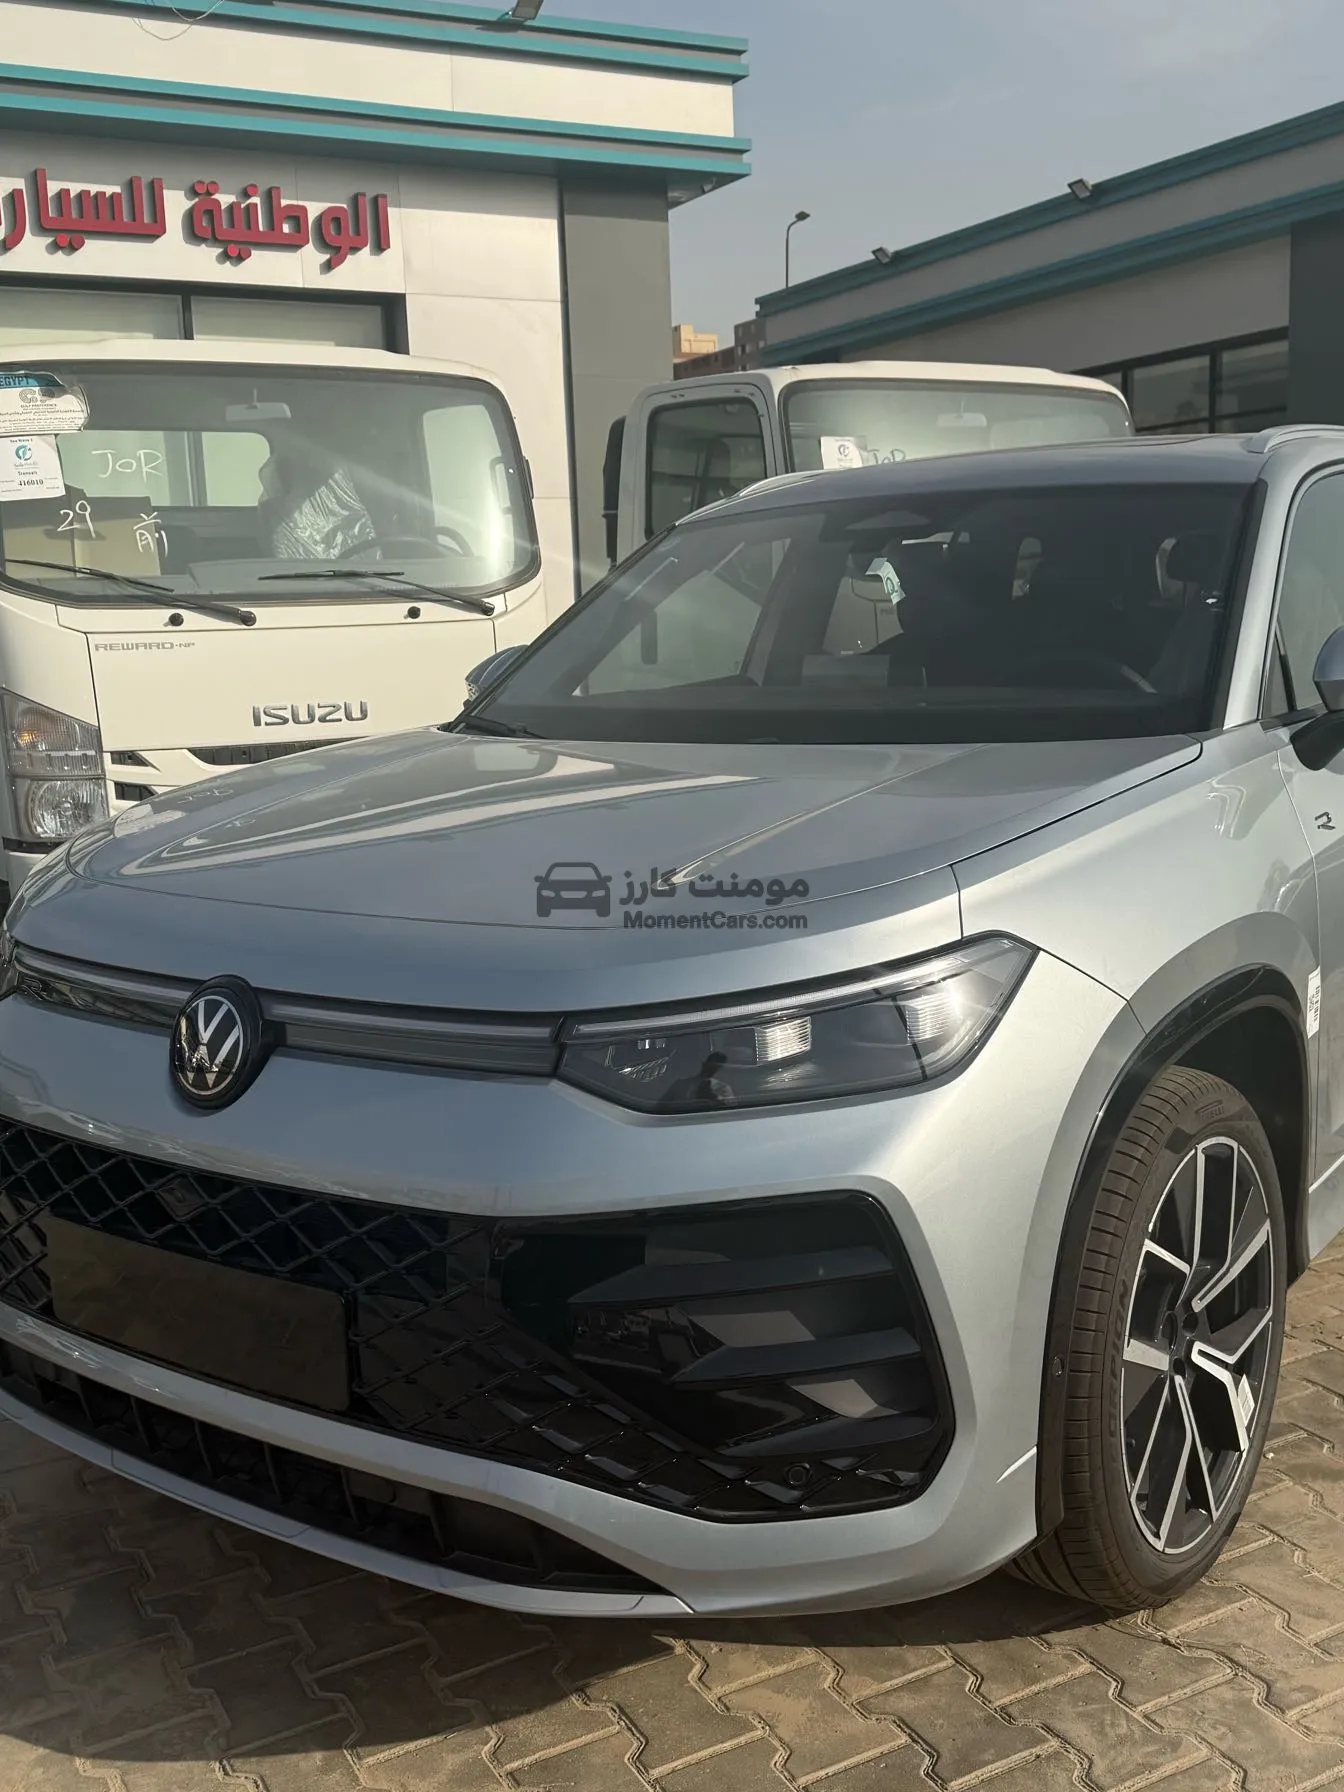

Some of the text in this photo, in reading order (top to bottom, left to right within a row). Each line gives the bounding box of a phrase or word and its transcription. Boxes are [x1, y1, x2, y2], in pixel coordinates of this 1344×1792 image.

[0, 168, 391, 272] الوطنية للسيار
[57, 500, 96, 539] 29
[252, 700, 369, 727] ISUZU
